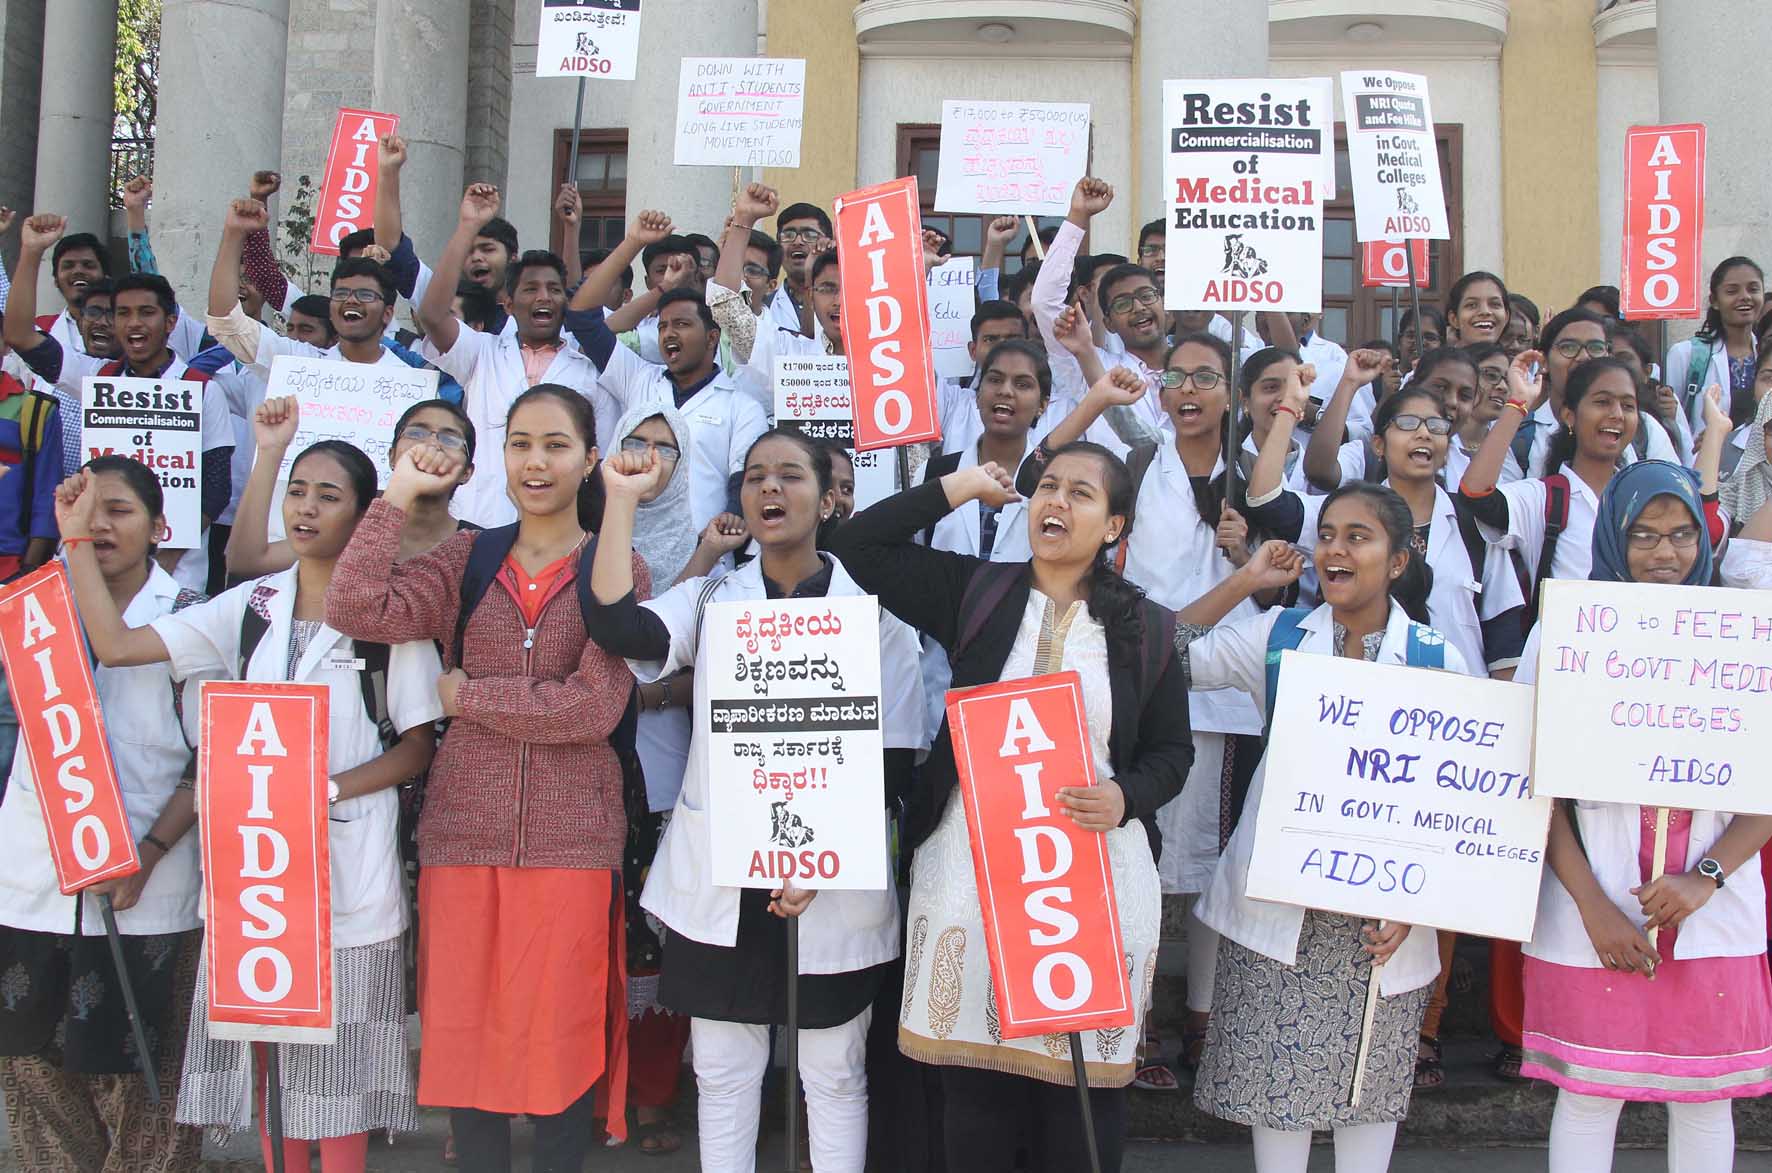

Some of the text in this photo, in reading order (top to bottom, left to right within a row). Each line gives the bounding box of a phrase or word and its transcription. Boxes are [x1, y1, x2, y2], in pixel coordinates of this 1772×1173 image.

[560, 56, 611, 74] AIDSO
[697, 63, 785, 77] DOWN WITH
[1362, 76, 1416, 92] We Oppose
[698, 100, 784, 115] GOVERNMENT
[1182, 93, 1311, 127] Resist
[1369, 98, 1390, 110] NRI
[683, 120, 716, 135] LONG
[720, 120, 748, 132] LIVE
[1365, 114, 1386, 126] and
[704, 136, 774, 150] MOVEMENT
[1179, 132, 1313, 149] Commercialisation
[1376, 135, 1420, 151] in Govt.
[748, 149, 793, 166] AIDSO
[1233, 155, 1258, 174] of
[1377, 153, 1423, 168] Medical
[1377, 170, 1426, 187] Colleges
[1176, 178, 1314, 205] Medical
[1175, 207, 1315, 231] Education
[1384, 216, 1431, 234] AIDSO
[1643, 135, 1681, 307] AIDSO
[1202, 280, 1284, 303] AIDSO
[858, 202, 912, 435] AIDSO
[783, 363, 813, 371] ₹17000
[834, 379, 850, 387] ₹30
[93, 383, 193, 411] Resist
[90, 413, 194, 428] Commercialisation
[132, 431, 152, 446] of
[736, 609, 842, 654] ವೈದ್ಯಕೀಯ
[1576, 604, 1618, 632] NO
[1637, 614, 1660, 630] to
[1673, 608, 1742, 640] FEE
[734, 652, 846, 696] ಶಿಕ್ಷಣವನ್ನು
[1554, 646, 1590, 673] IN
[1689, 658, 1772, 692] MEDI
[712, 701, 877, 733] ವ್ಯಾಪಾರೀಕರಣ ಮಾಡುವ
[1319, 694, 1504, 748] WE OPPOSE
[22, 592, 111, 871] AIDSO
[734, 736, 844, 767] ರಾಜ್ಯ ಸರ್ಕಾರಕ್ಕೆ
[1346, 747, 1421, 783] NRI
[753, 766, 827, 800] ಧಿಕ್ಕಾರ!!
[1294, 791, 1497, 836] IN GOVT. MEDICAL
[236, 702, 293, 1003] AIDSO
[999, 697, 1092, 1011] AIDSO
[1455, 840, 1541, 863] COLLEGES
[748, 850, 840, 879] AIDSO
[1300, 848, 1426, 895] AIDSO
